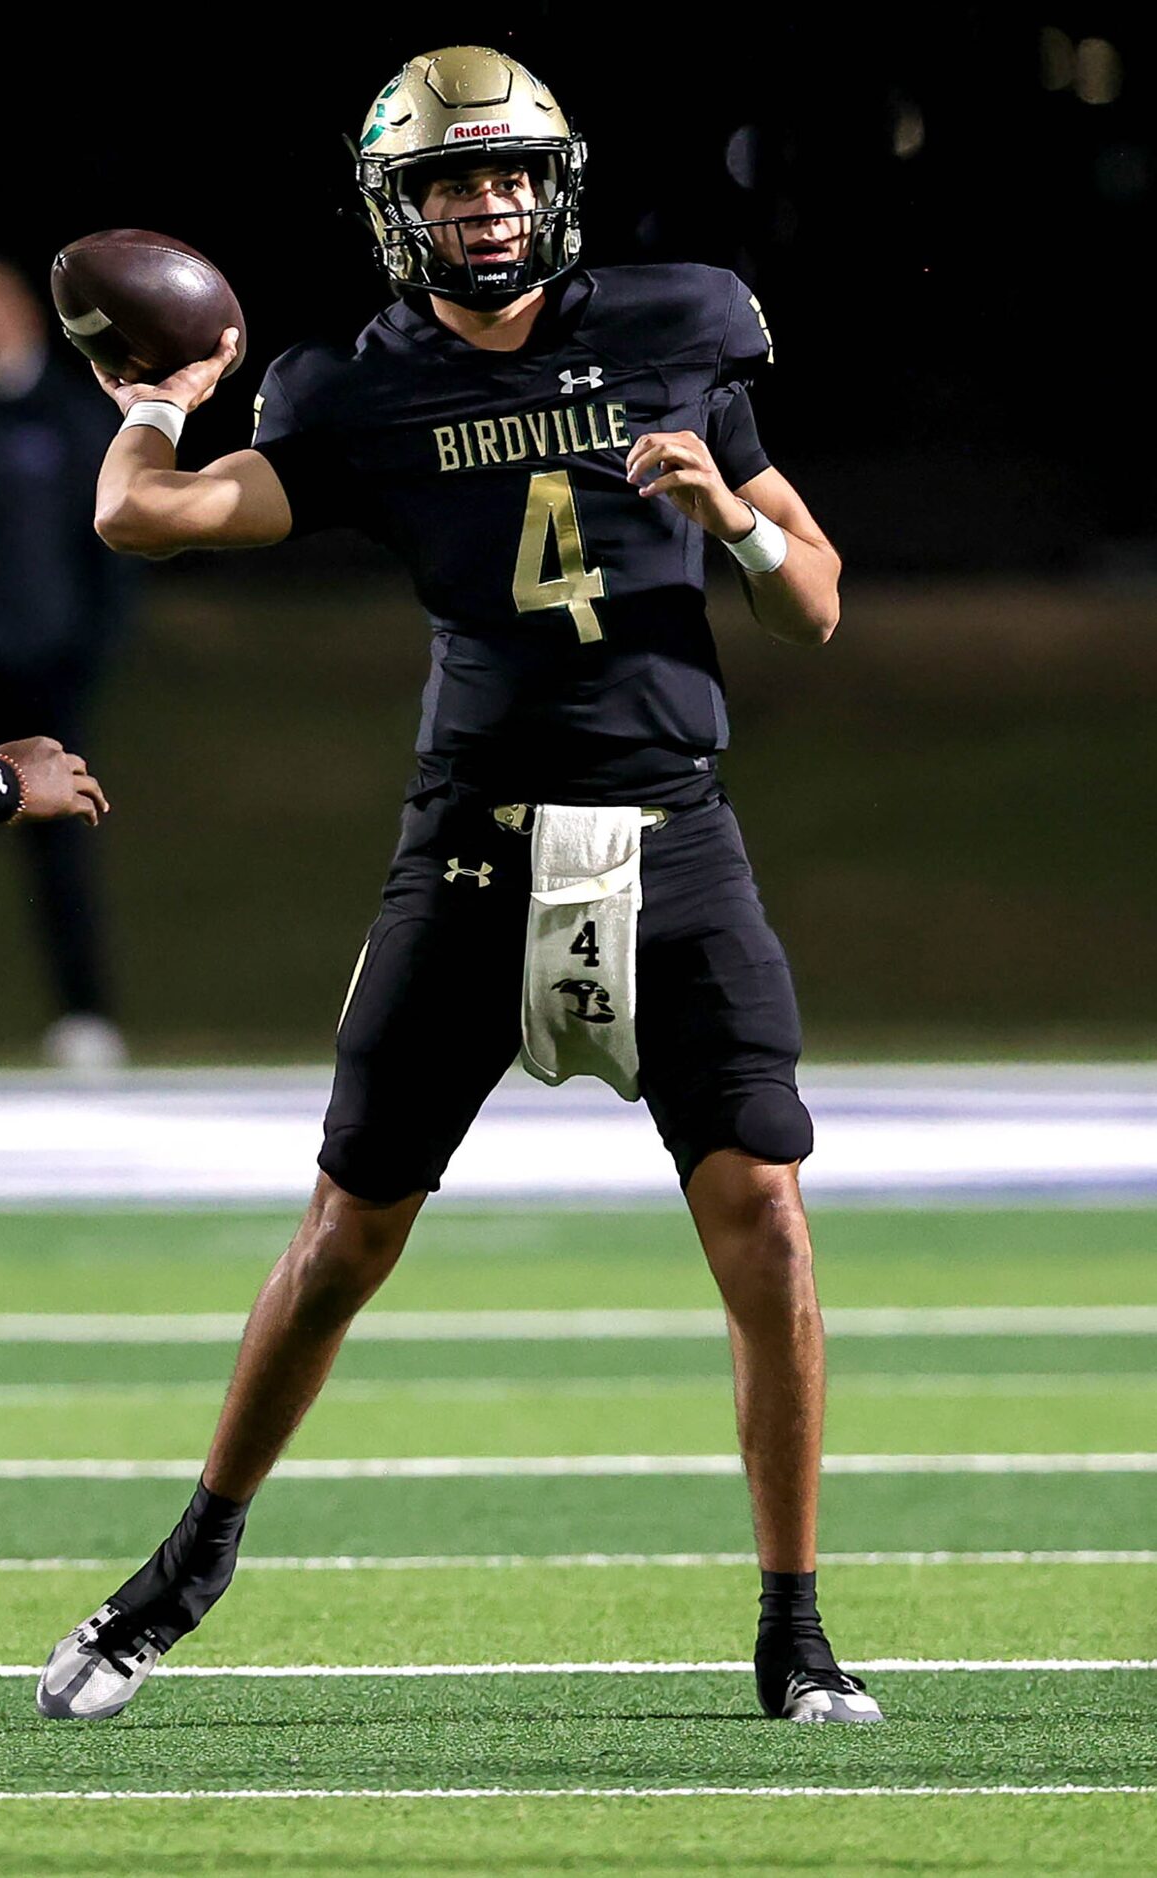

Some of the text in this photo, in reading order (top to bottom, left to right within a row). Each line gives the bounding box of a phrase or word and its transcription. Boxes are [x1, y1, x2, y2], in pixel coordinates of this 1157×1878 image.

[454, 123, 511, 139] Riddell
[432, 401, 631, 472] BIRDVILLE
[512, 469, 606, 644] 4
[570, 920, 600, 968] 4
